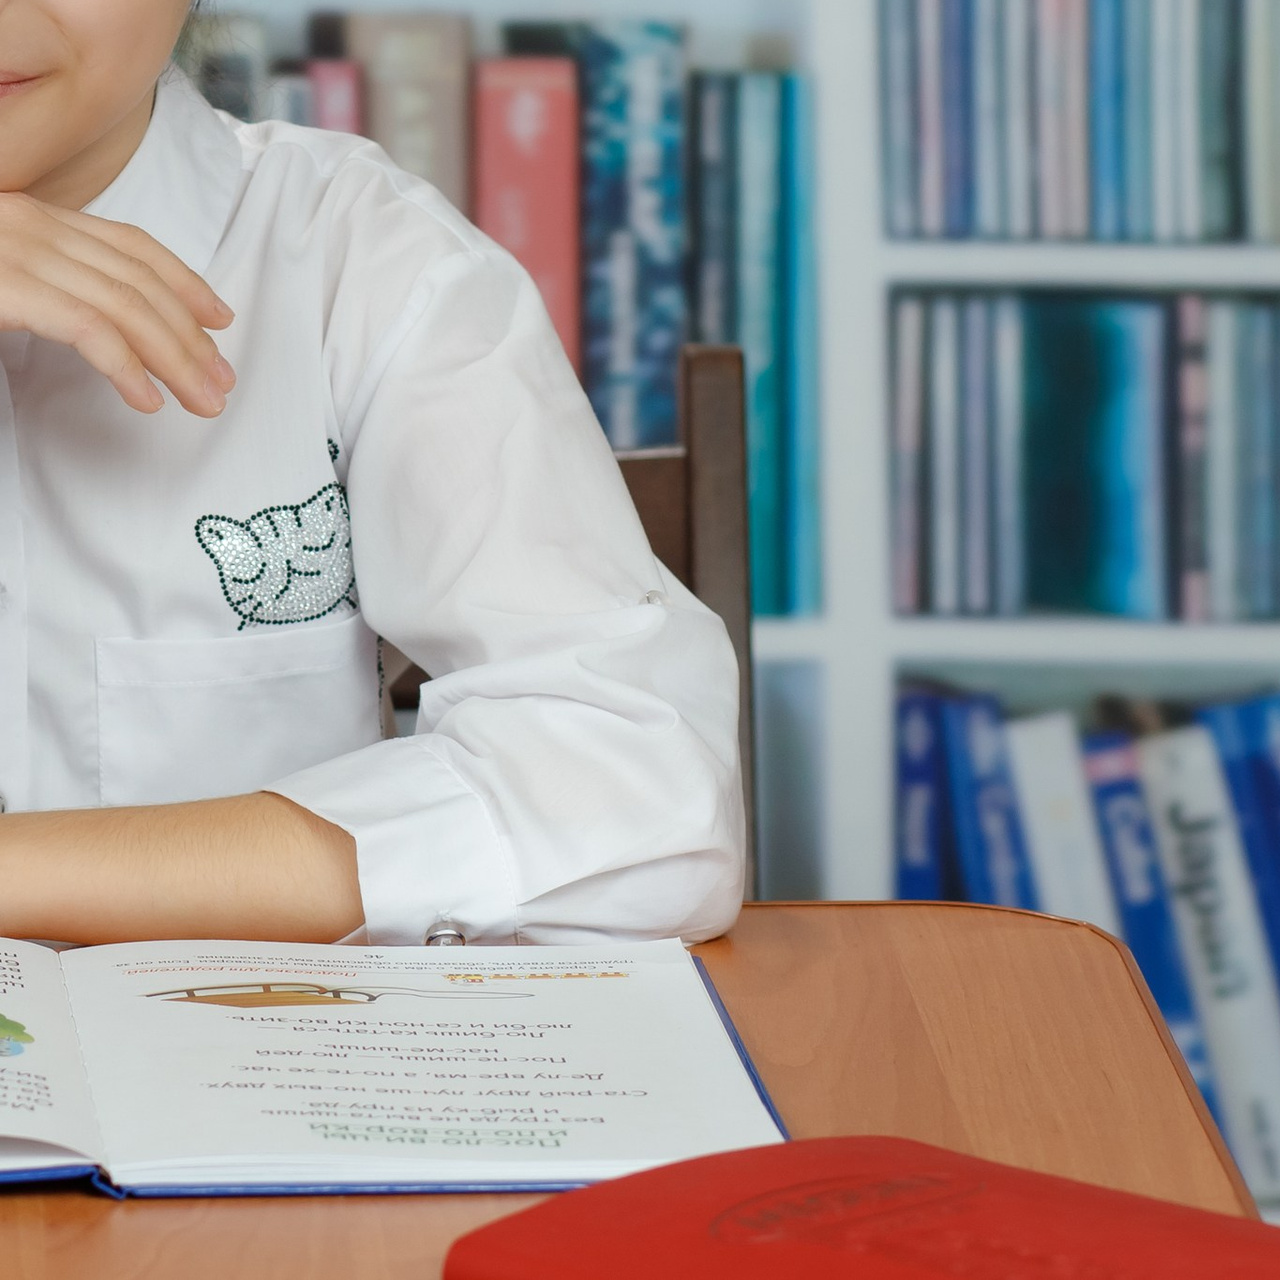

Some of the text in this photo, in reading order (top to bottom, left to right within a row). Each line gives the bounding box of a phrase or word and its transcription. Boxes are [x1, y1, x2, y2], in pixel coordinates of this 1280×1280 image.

[264, 968, 358, 978] Подсказка
[225, 1016, 328, 1024] во-зить.
[337, 1020, 462, 1029] са-ноч-ки
[292, 1026, 418, 1036] ка-тать-ся
[425, 1031, 545, 1039] Лю-бишь
[318, 1044, 499, 1054] нас-ме-шишь.
[255, 1050, 348, 1058] лю-дей
[390, 1055, 567, 1064] Пос-пе-шишь
[288, 1068, 395, 1077] по-те-хе
[533, 1073, 604, 1081] Де-лу
[272, 1084, 366, 1092] но-вых
[375, 1088, 464, 1096] луч-ше
[476, 1089, 530, 1097] друг
[539, 1090, 648, 1098] Ста-рый
[301, 1101, 395, 1111] пру-да.
[441, 1106, 535, 1115] рыб-ку
[260, 1110, 420, 1121] вы-та-щишь
